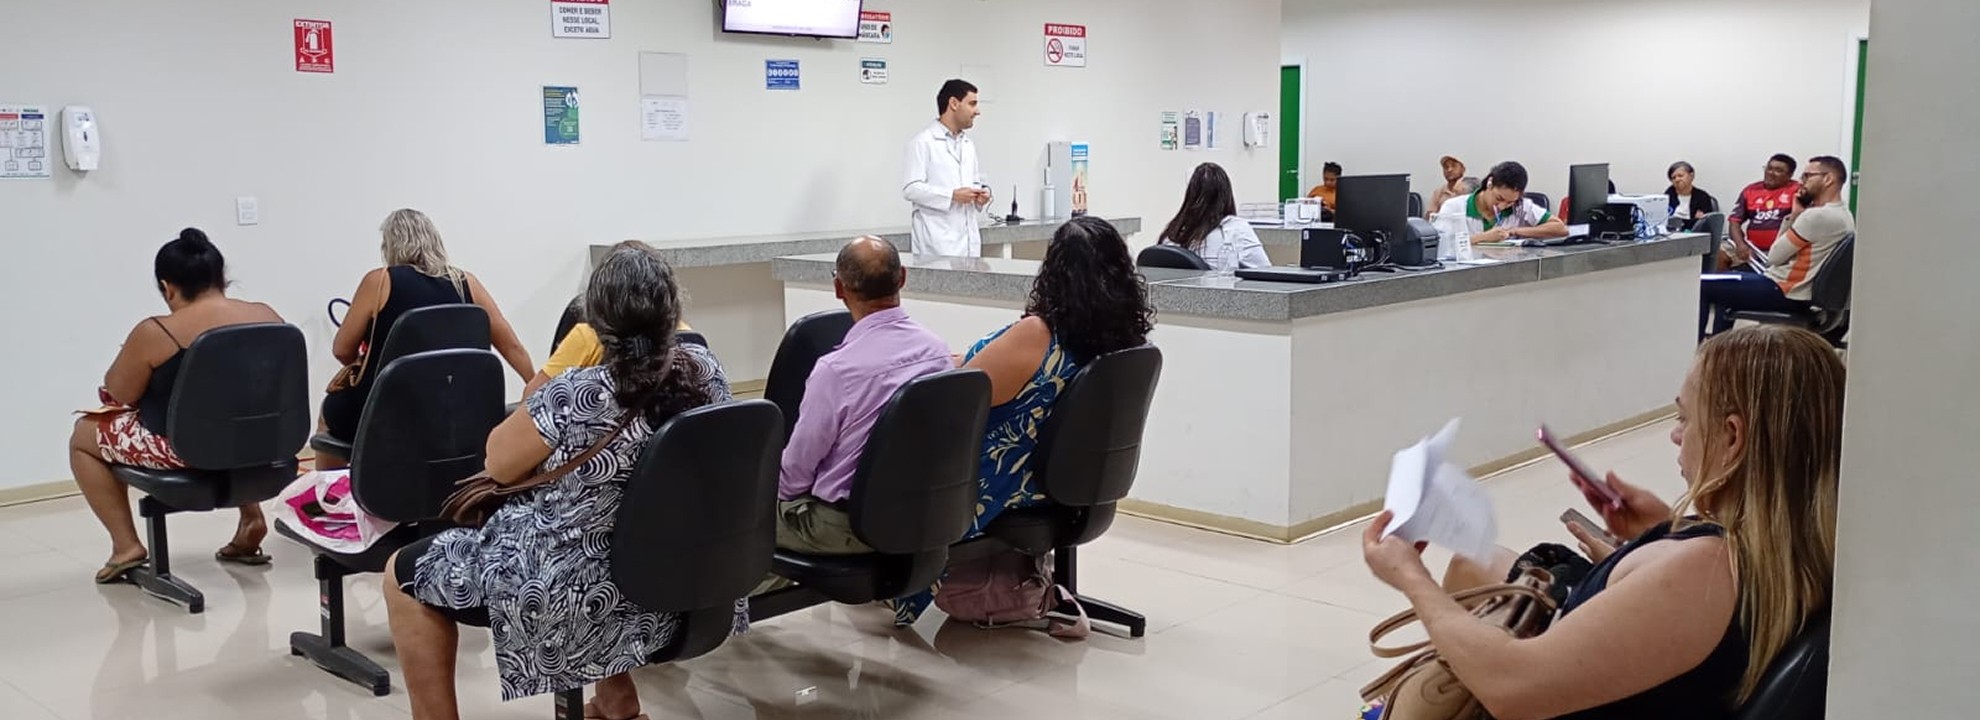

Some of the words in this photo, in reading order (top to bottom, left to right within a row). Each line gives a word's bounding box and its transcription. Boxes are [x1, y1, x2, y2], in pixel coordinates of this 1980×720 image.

[559, 6, 578, 14] COMER
[584, 7, 602, 15] BEBER
[295, 21, 330, 29] EXTINTOR
[1047, 25, 1083, 36] PROIBIDO
